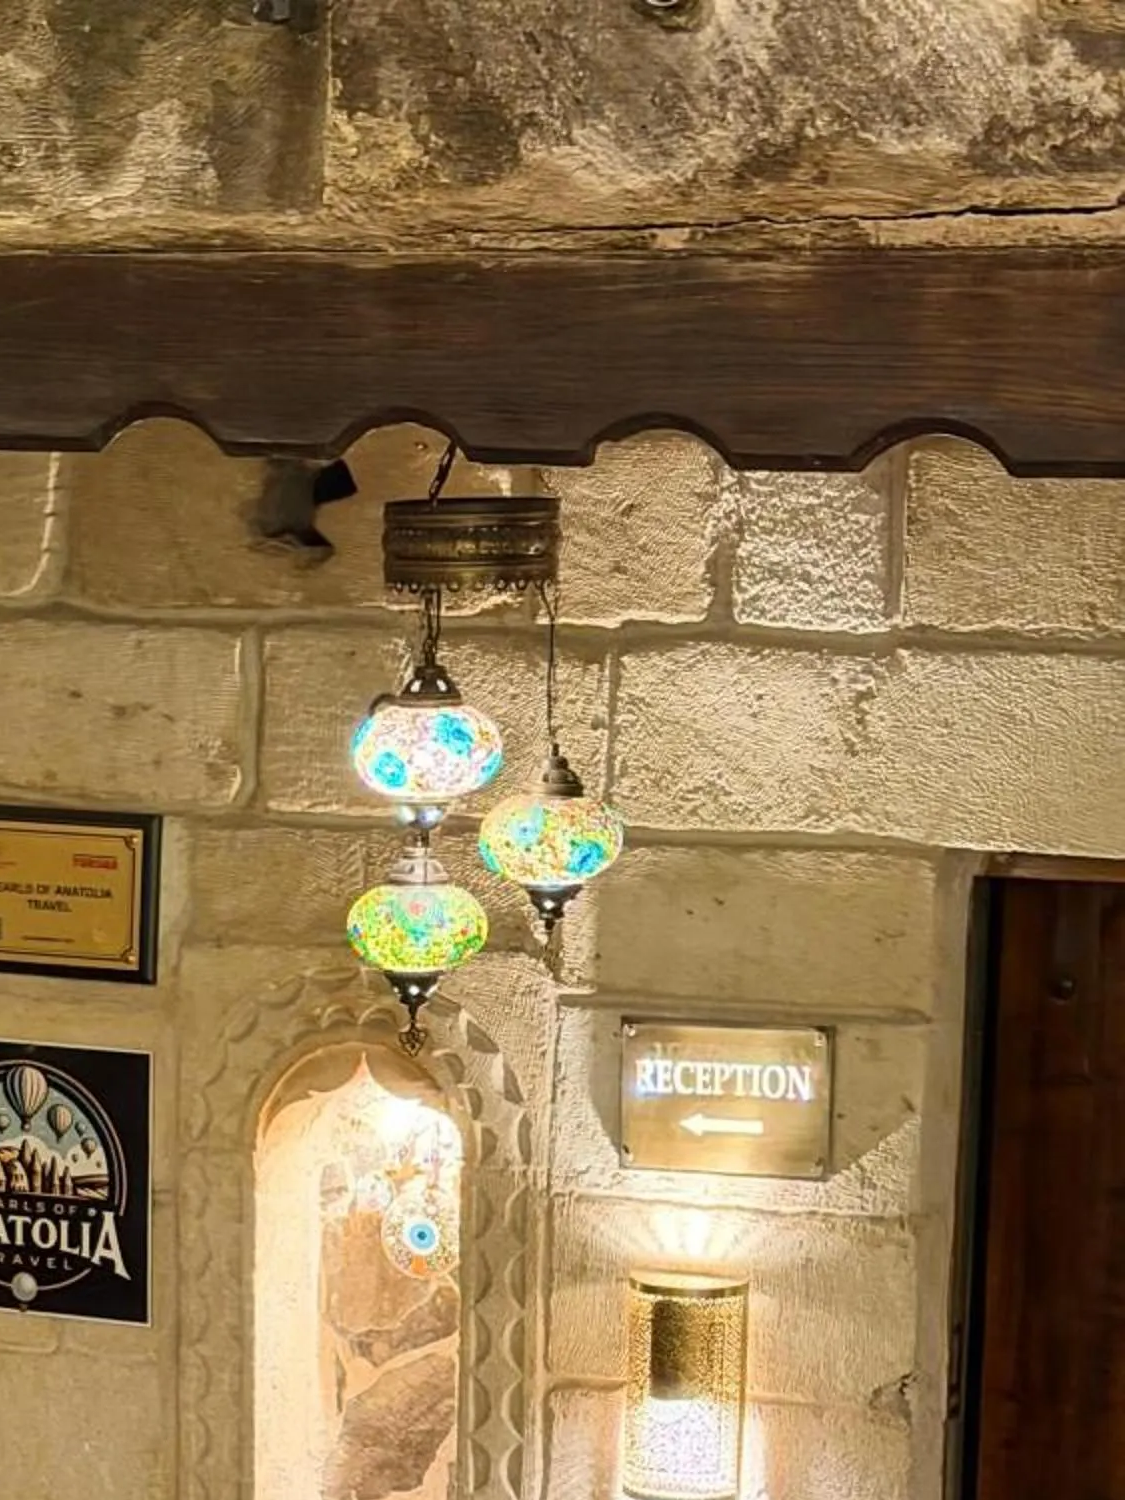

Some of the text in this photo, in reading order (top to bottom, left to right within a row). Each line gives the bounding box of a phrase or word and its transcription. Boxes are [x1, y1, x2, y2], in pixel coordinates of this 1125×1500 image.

[55, 885, 114, 899] ANATOLIA
[27, 899, 74, 912] TRAVEL
[634, 1058, 813, 1101] RECEPTION
